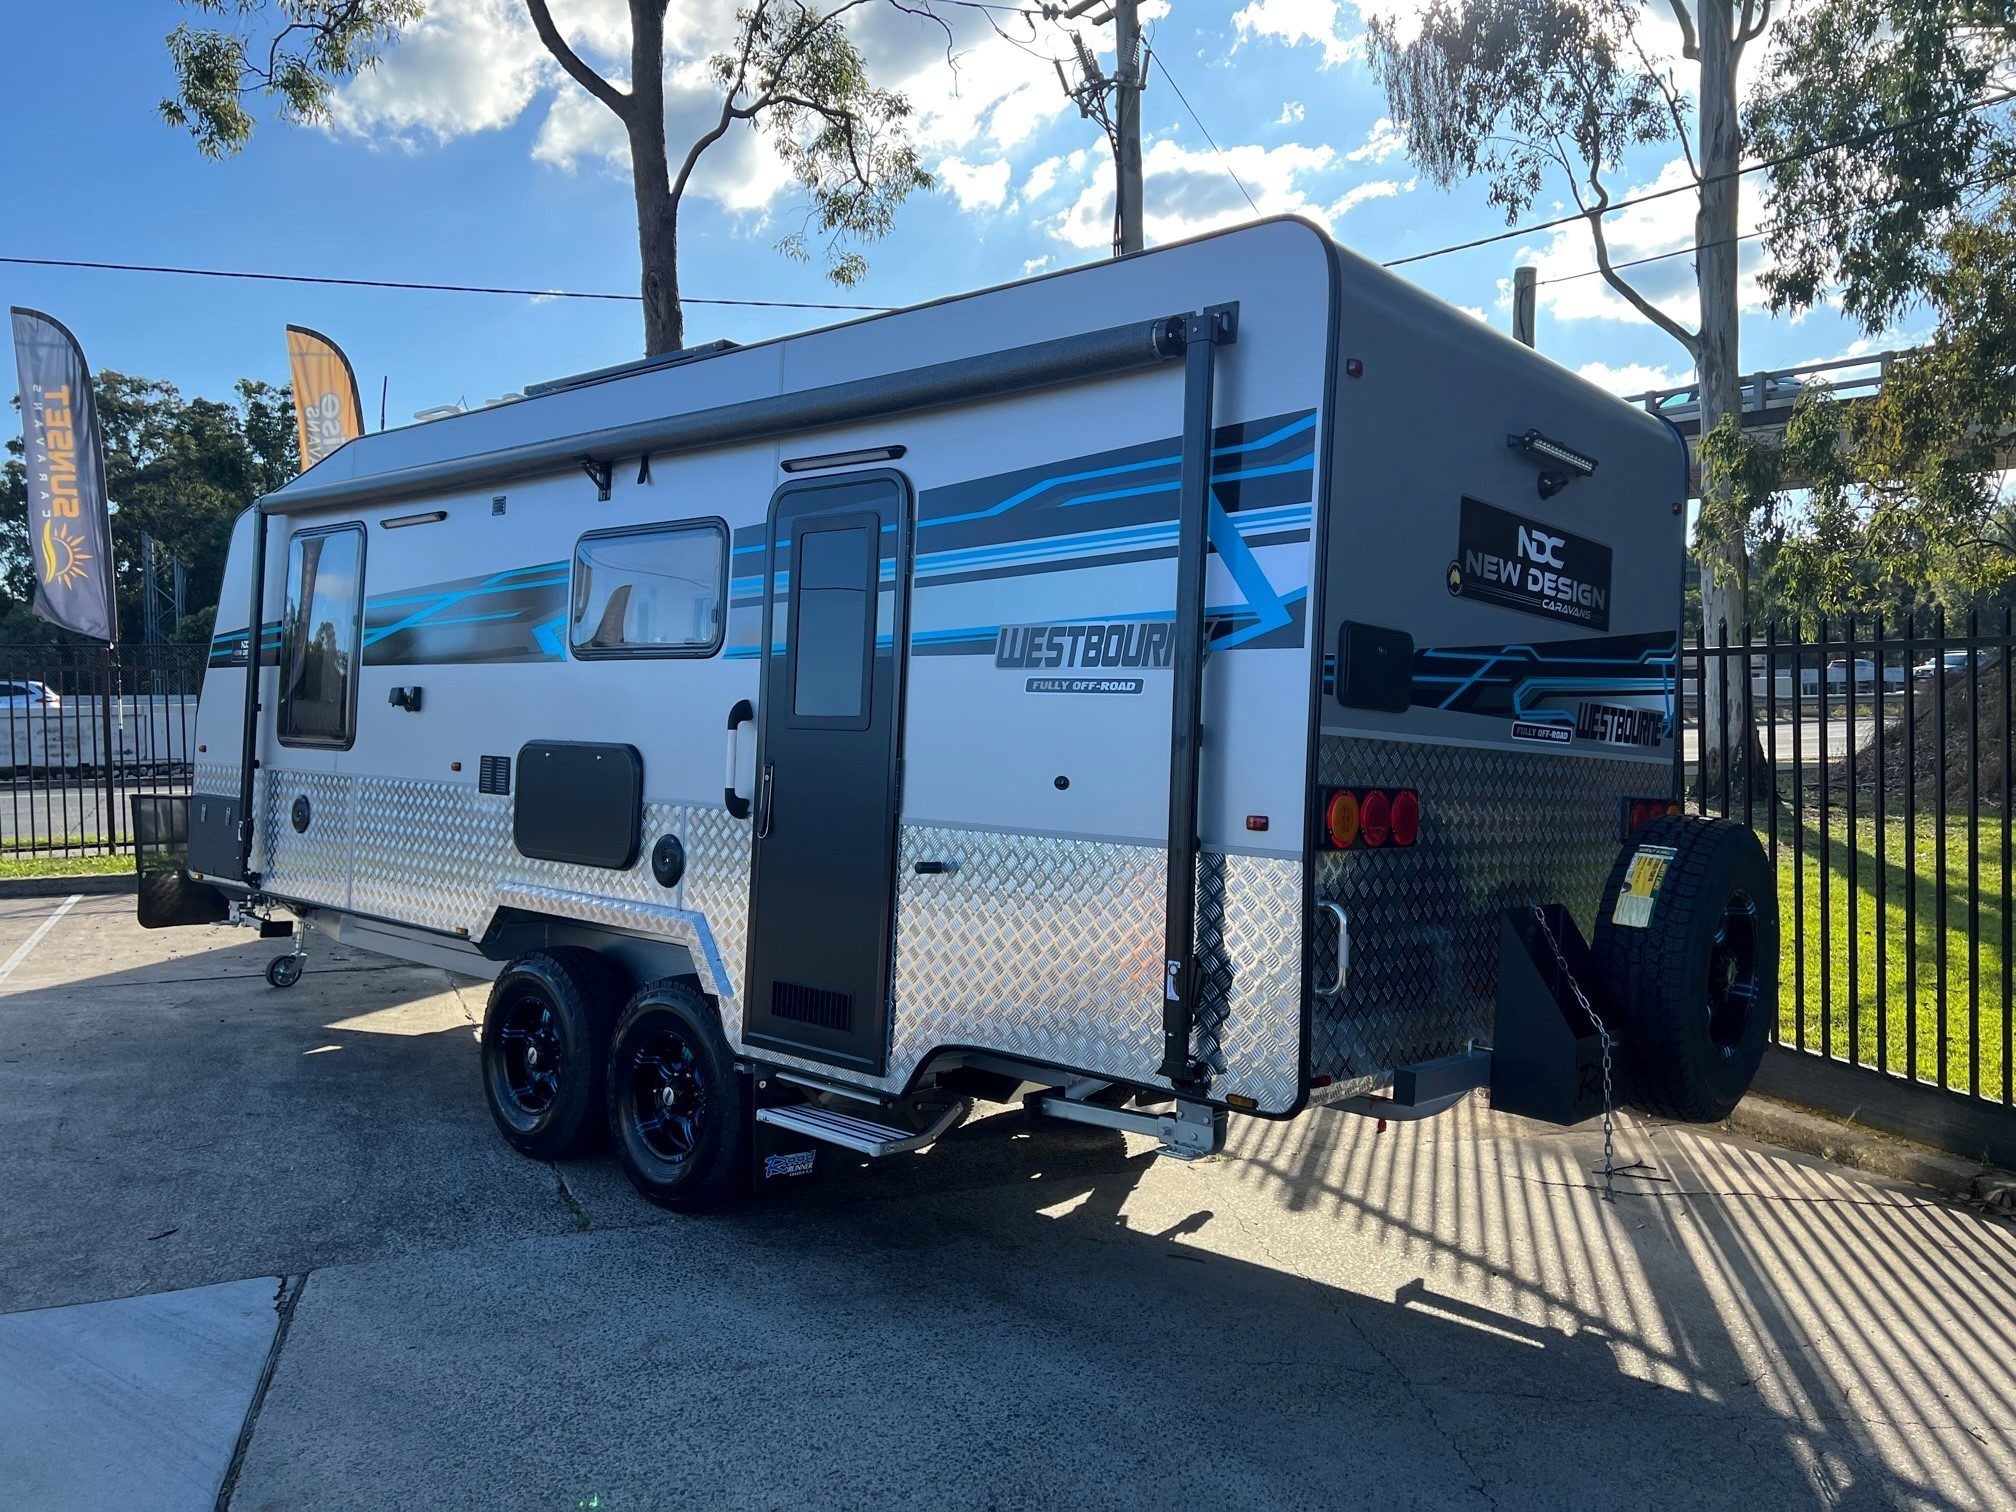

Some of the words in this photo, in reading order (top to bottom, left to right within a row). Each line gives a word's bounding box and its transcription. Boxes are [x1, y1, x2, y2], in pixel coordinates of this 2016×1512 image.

[1517, 525, 1566, 569] NDC
[1465, 549, 1522, 587] NEW
[1528, 567, 1606, 610] DESIGN
[1542, 599, 1592, 619] CARAVANS
[1032, 680, 1070, 691] FULLY
[1072, 680, 1136, 692] OFF-ROAD
[1516, 726, 1537, 737] FULLY
[1537, 728, 1569, 741] OFF-ROAD
[1576, 702, 1665, 747] WESTBOURNE
